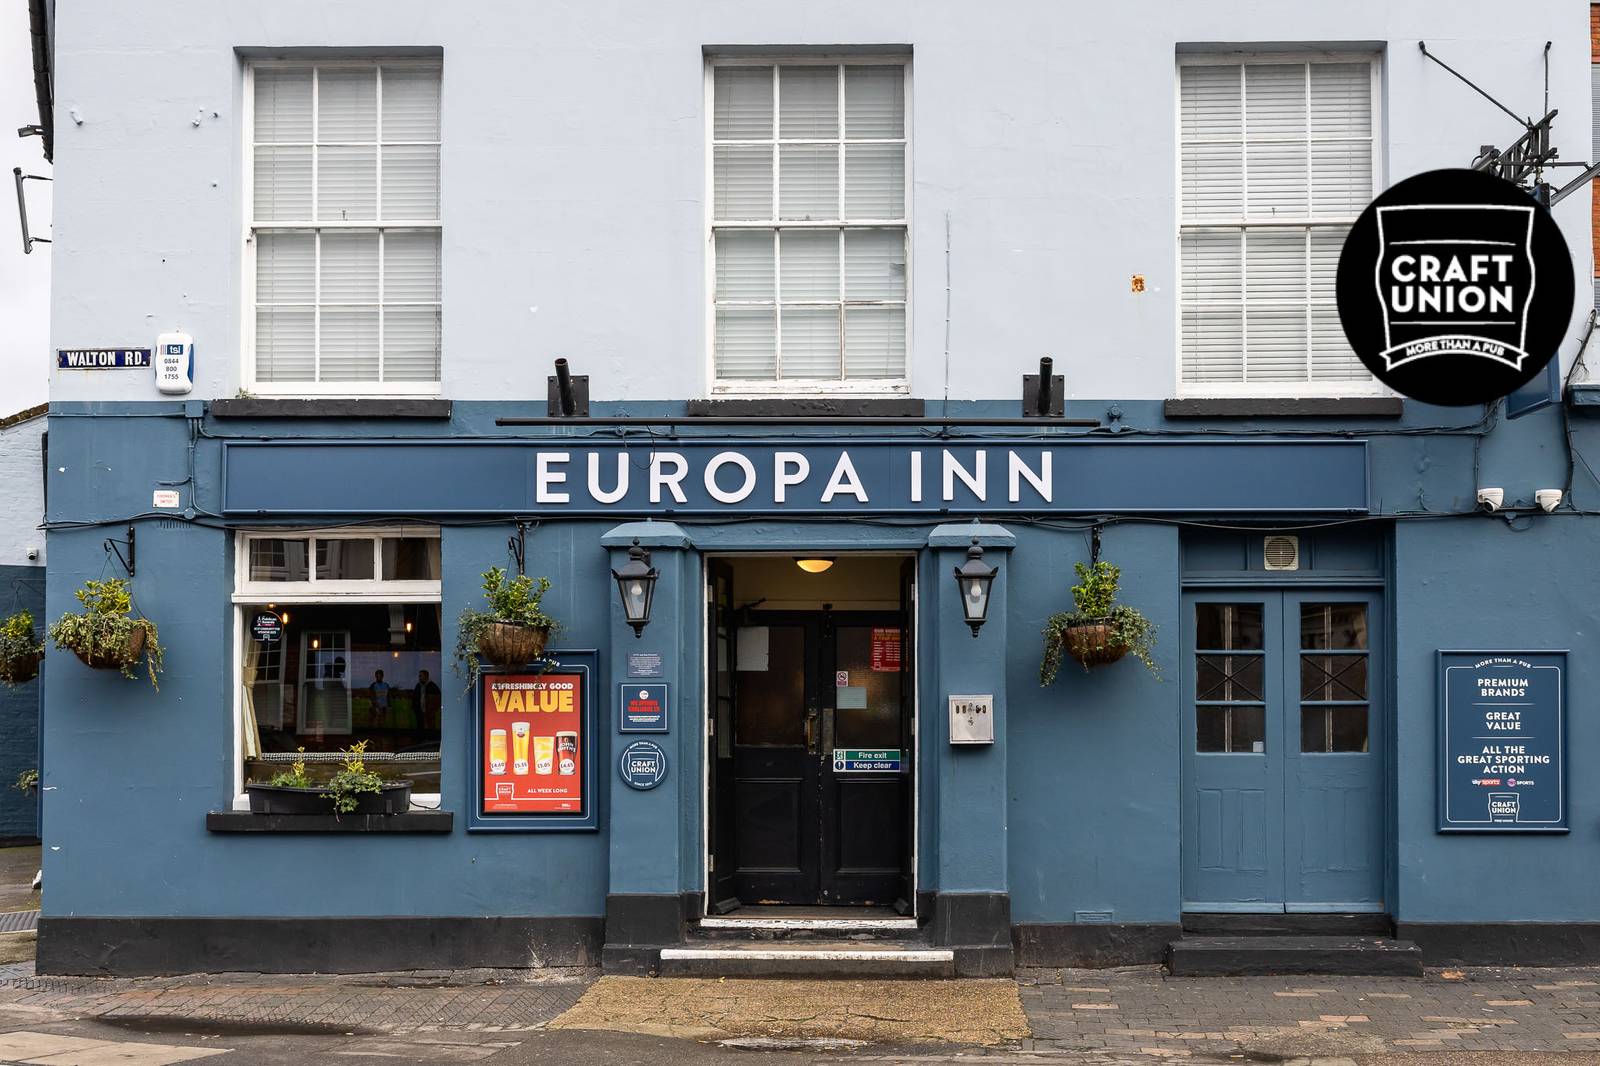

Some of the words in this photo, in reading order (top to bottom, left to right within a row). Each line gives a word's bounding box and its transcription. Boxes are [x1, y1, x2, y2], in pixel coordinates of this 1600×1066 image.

[169, 344, 182, 354] tsi
[67, 351, 116, 367] WALTON
[125, 351, 146, 366] RD.
[536, 450, 869, 504] EUROPA
[910, 449, 1053, 503] INN
[1475, 659, 1493, 669] MORE
[1519, 660, 1531, 668] PUB
[549, 682, 574, 690] GOOD
[1477, 678, 1529, 687] PREMIUM
[1481, 688, 1525, 697] BRANDS
[492, 690, 574, 712] VALUE
[1485, 711, 1521, 720] GREAT
[1485, 721, 1521, 730] VALUE
[1482, 746, 1502, 754] ALL
[1504, 745, 1525, 754] THE
[858, 751, 873, 759] Fire
[1457, 755, 1492, 764] GREAT
[1495, 755, 1550, 764] SPORTING
[853, 761, 872, 770] Keep
[873, 761, 892, 769] clear
[1483, 765, 1525, 774] ACTION
